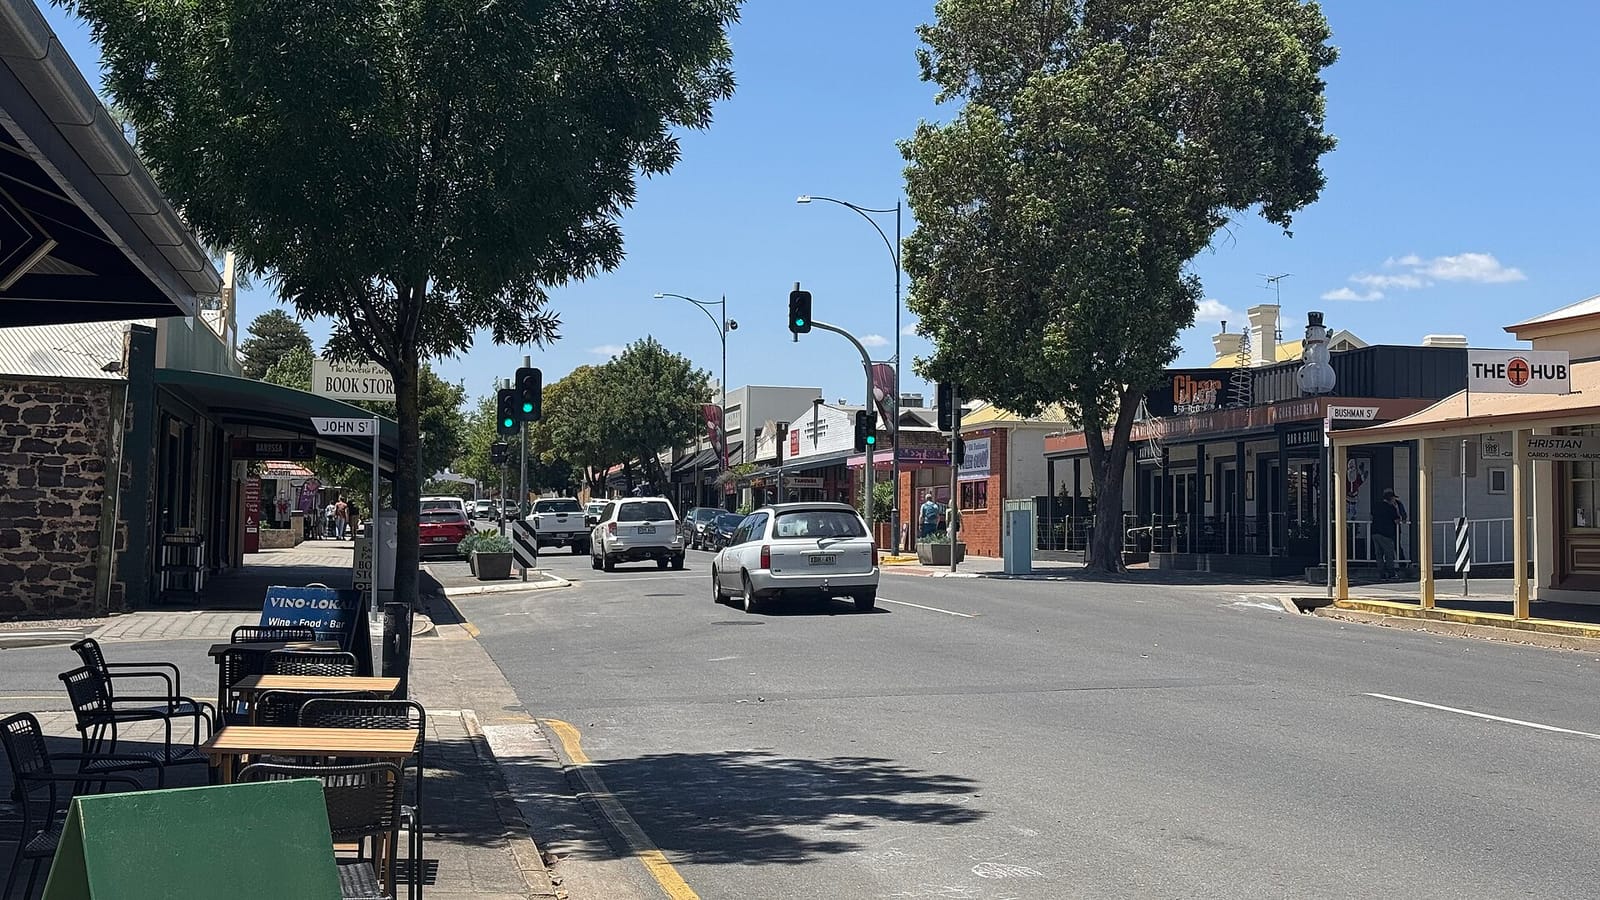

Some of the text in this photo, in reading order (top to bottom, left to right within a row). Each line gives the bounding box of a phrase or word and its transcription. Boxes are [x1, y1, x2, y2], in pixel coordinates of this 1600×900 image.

[1472, 363, 1567, 380] THE HUB
[325, 376, 396, 395] BOOK STOR
[1334, 408, 1364, 418] BUSHMAN
[322, 421, 354, 433] JOHN
[1302, 430, 1319, 443] GRILL
[1527, 439, 1582, 449] HRISTIAN
[268, 617, 345, 629] Wine Food Bar
